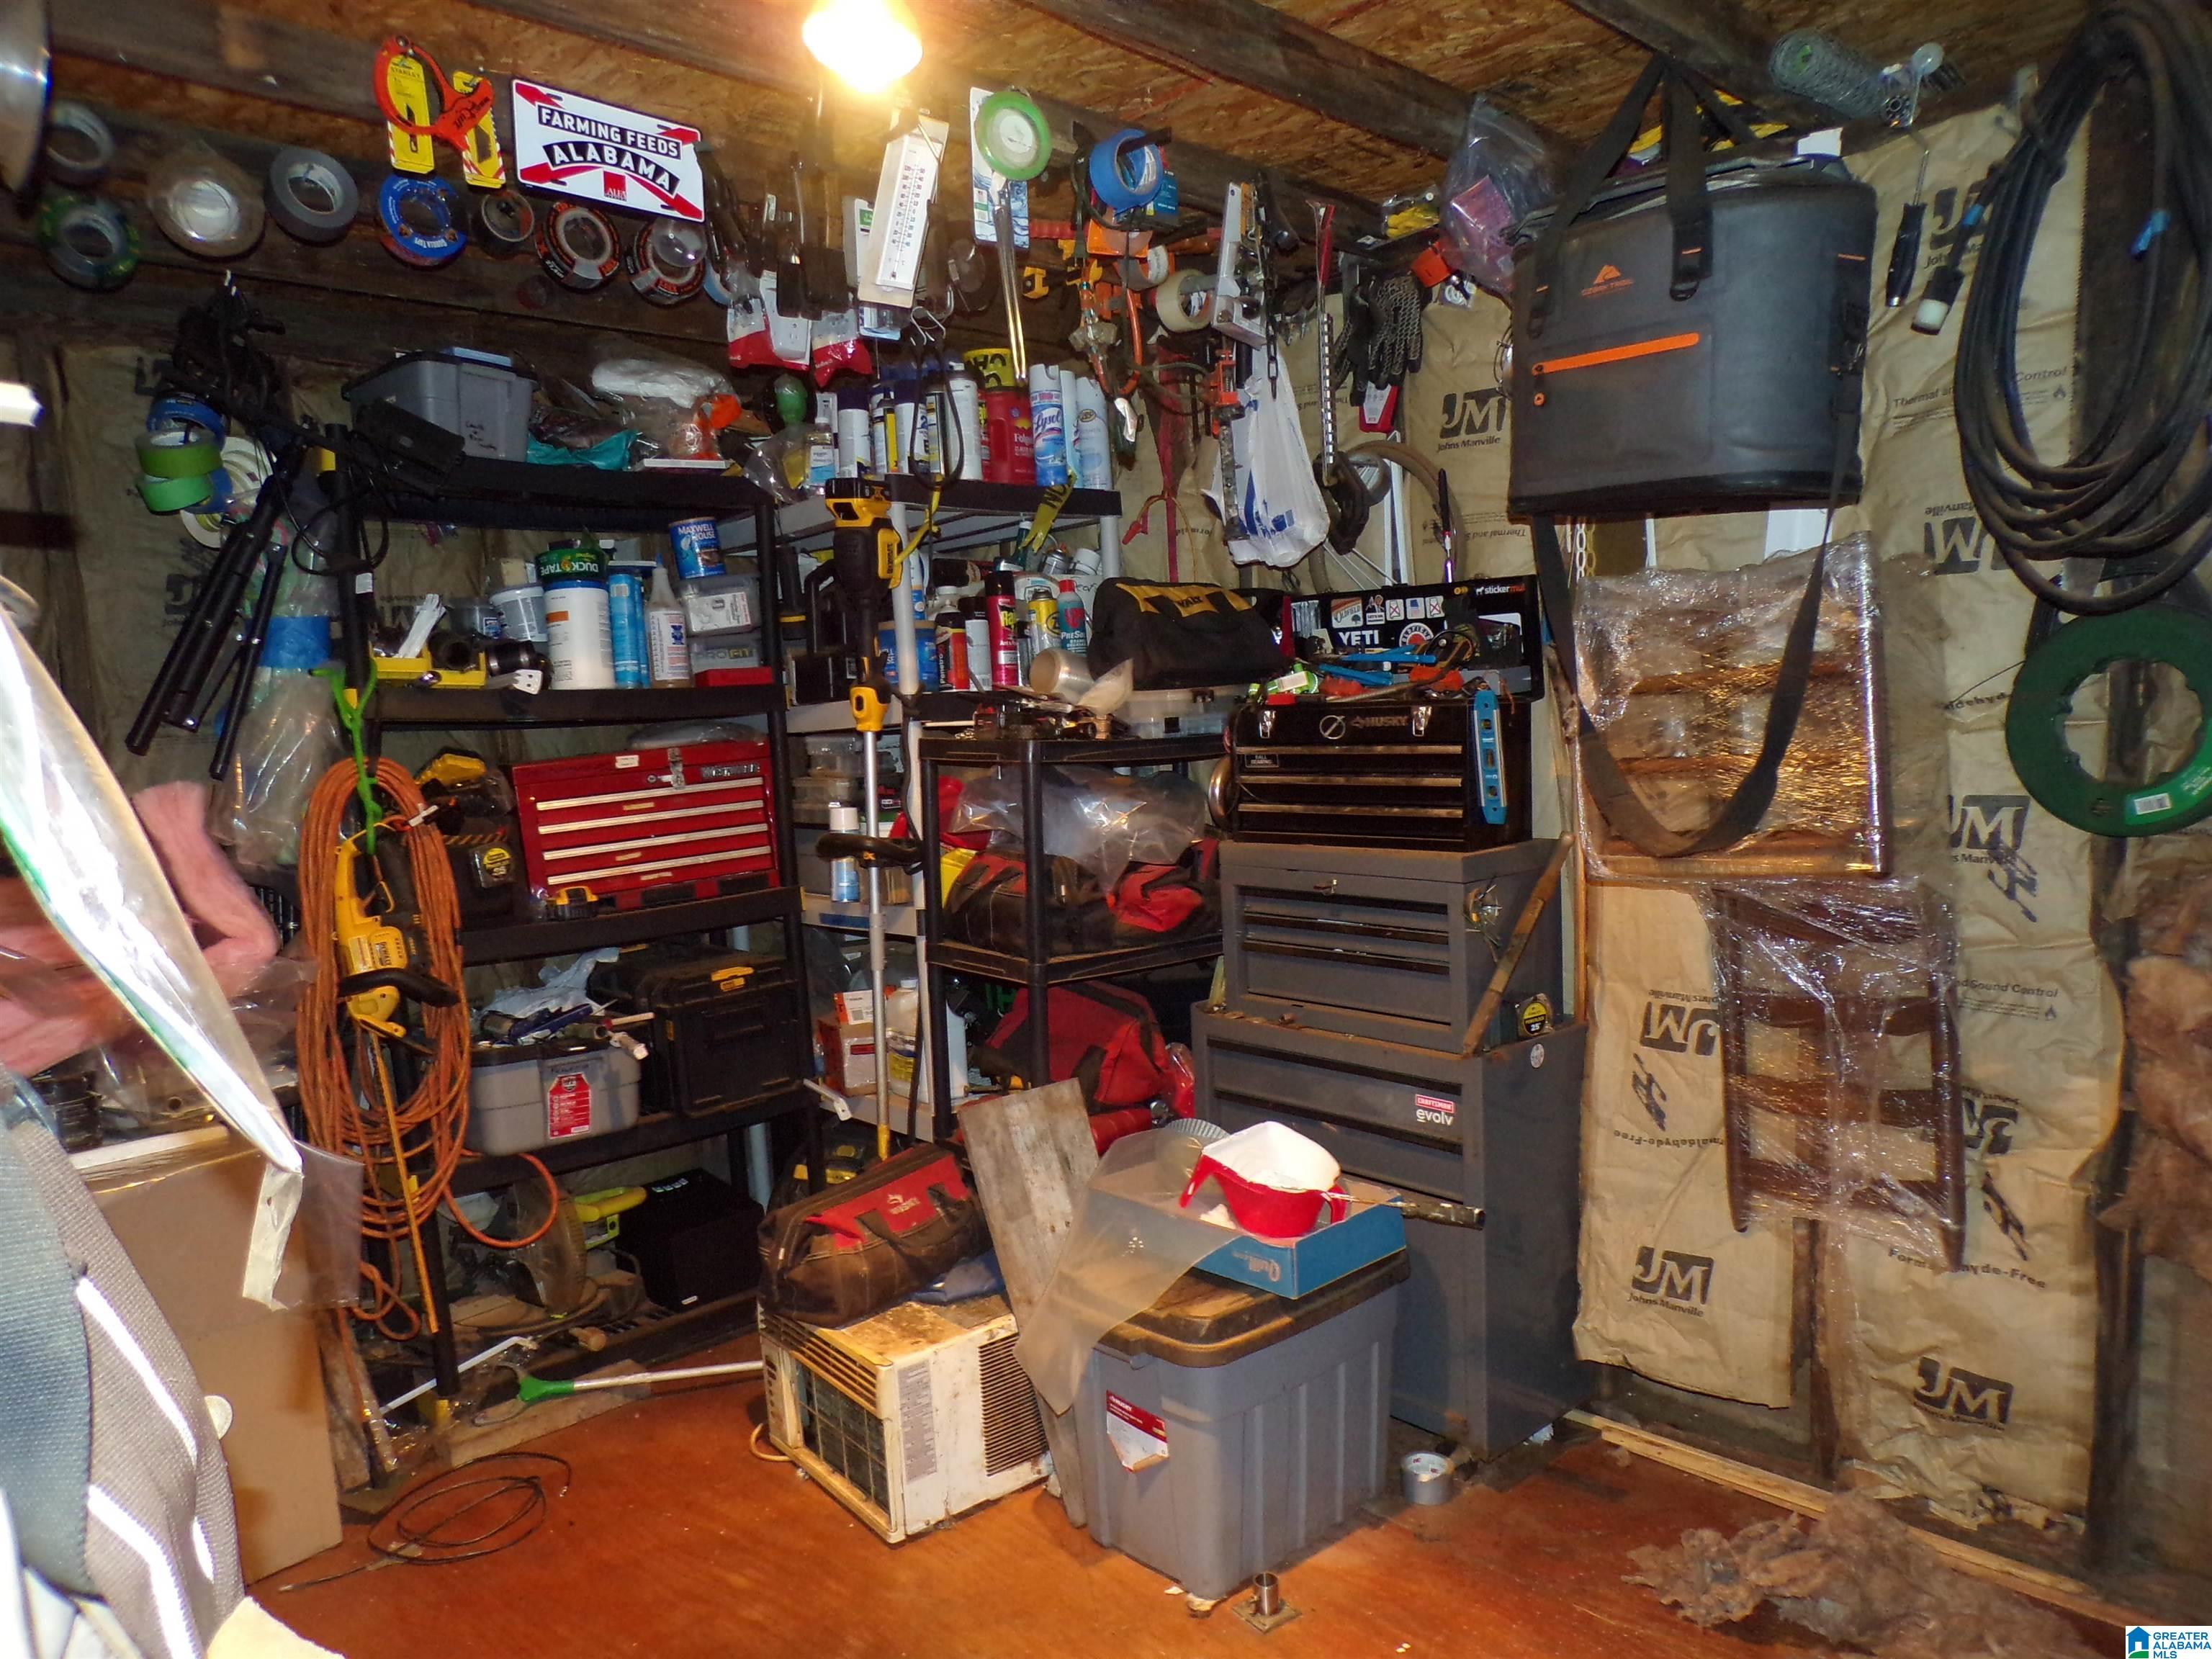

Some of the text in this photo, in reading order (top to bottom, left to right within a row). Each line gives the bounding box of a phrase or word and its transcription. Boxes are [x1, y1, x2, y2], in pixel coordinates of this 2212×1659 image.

[541, 108, 678, 156] FARMING FEEDS
[553, 143, 671, 192] ALABAMA
[1035, 413, 1062, 429] Lysol
[1437, 436, 1501, 451] Johns Manville
[678, 523, 714, 536] MAXWELL
[540, 561, 599, 575] DUCK TAPE
[1334, 605, 1361, 624] OLDFIELD
[1338, 629, 1380, 647] YETI
[1969, 979, 2008, 993] Sound
[2011, 982, 2059, 999] Control
[1640, 1001, 1718, 1056] JM
[1416, 1108, 1454, 1125] evolv
[1613, 1128, 1724, 1148] rmaldehyde-Free
[1632, 1246, 1714, 1305] JM
[1627, 1292, 1704, 1318] Johns Manville
[1913, 1357, 2014, 1424] JM
